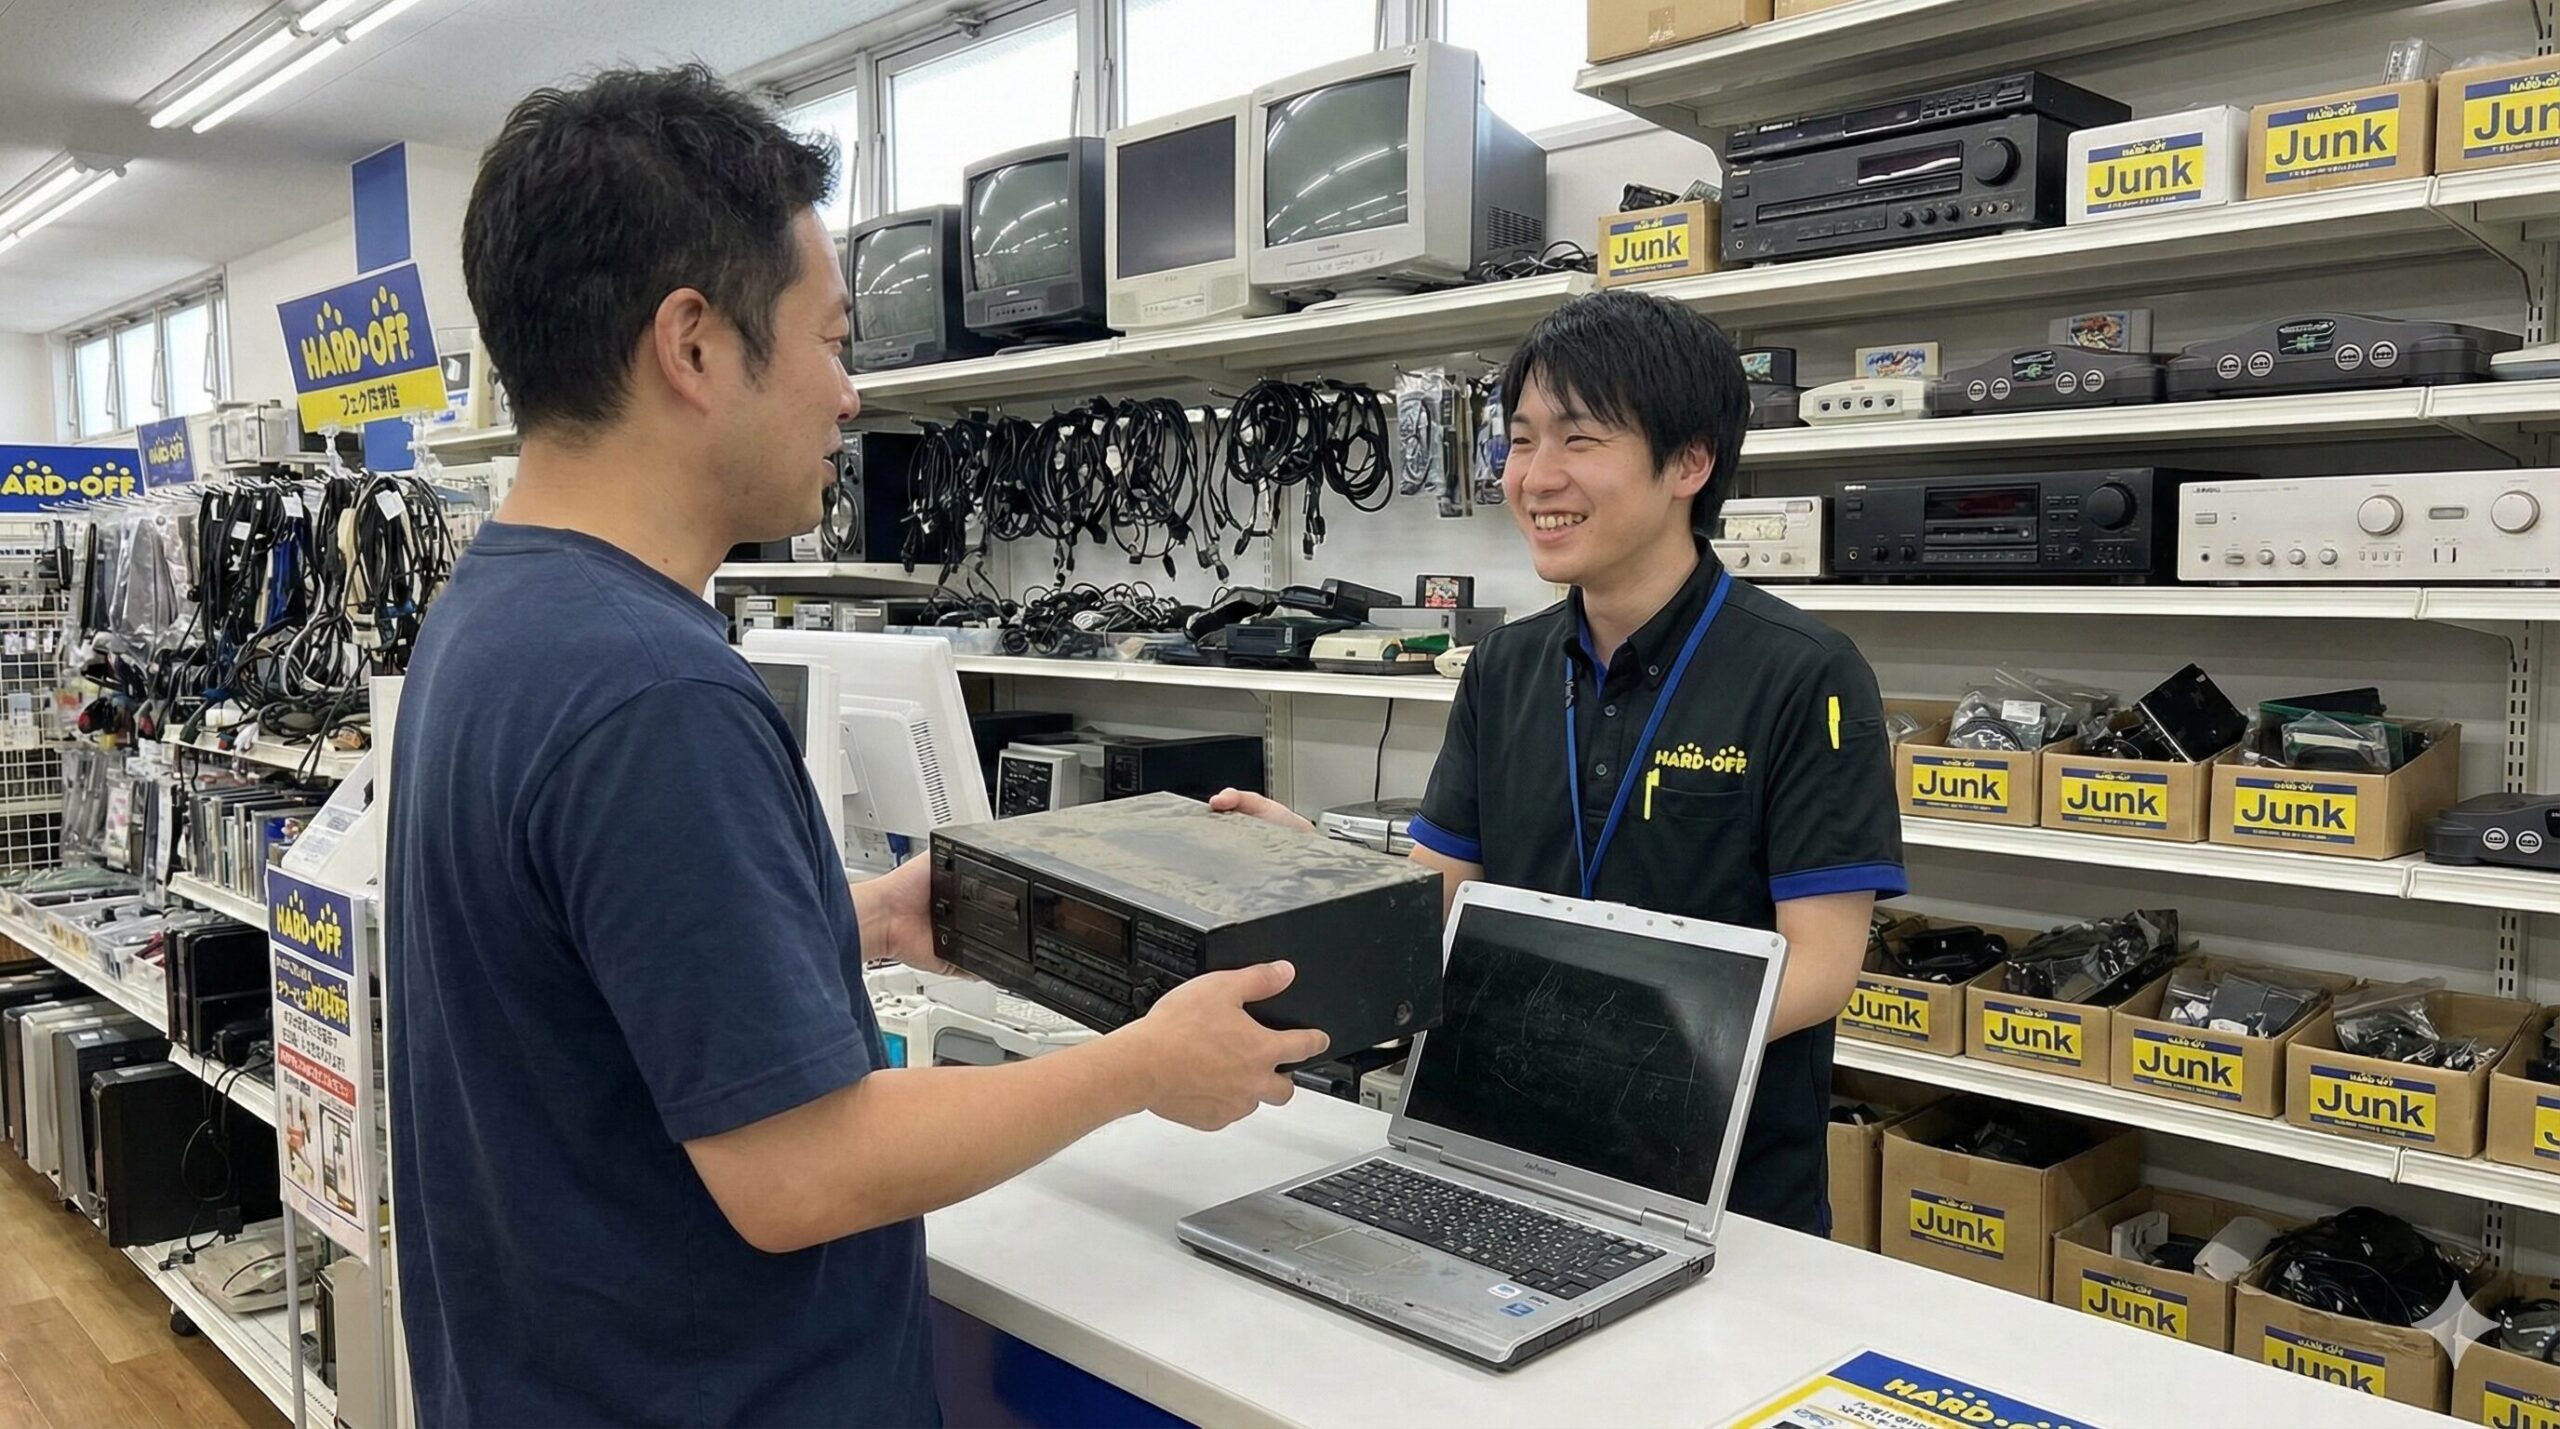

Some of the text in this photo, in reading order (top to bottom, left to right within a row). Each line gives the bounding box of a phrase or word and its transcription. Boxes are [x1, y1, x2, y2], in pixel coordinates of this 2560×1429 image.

[2275, 118, 2388, 166] Junk
[2094, 154, 2193, 198] Junk
[1615, 230, 1682, 264] Junk
[0, 473, 136, 497] ARD·OFF
[1918, 770, 2001, 801] Junk
[2067, 784, 2159, 816] Junk
[2241, 794, 2347, 829] Junk
[1848, 993, 1922, 1029] Junk
[1989, 1017, 2073, 1053] Junk
[2139, 1046, 2234, 1087] Junk
[2318, 1084, 2426, 1127] Junk
[1917, 1206, 1997, 1247] Junk
[2088, 1287, 2178, 1334] Junk
